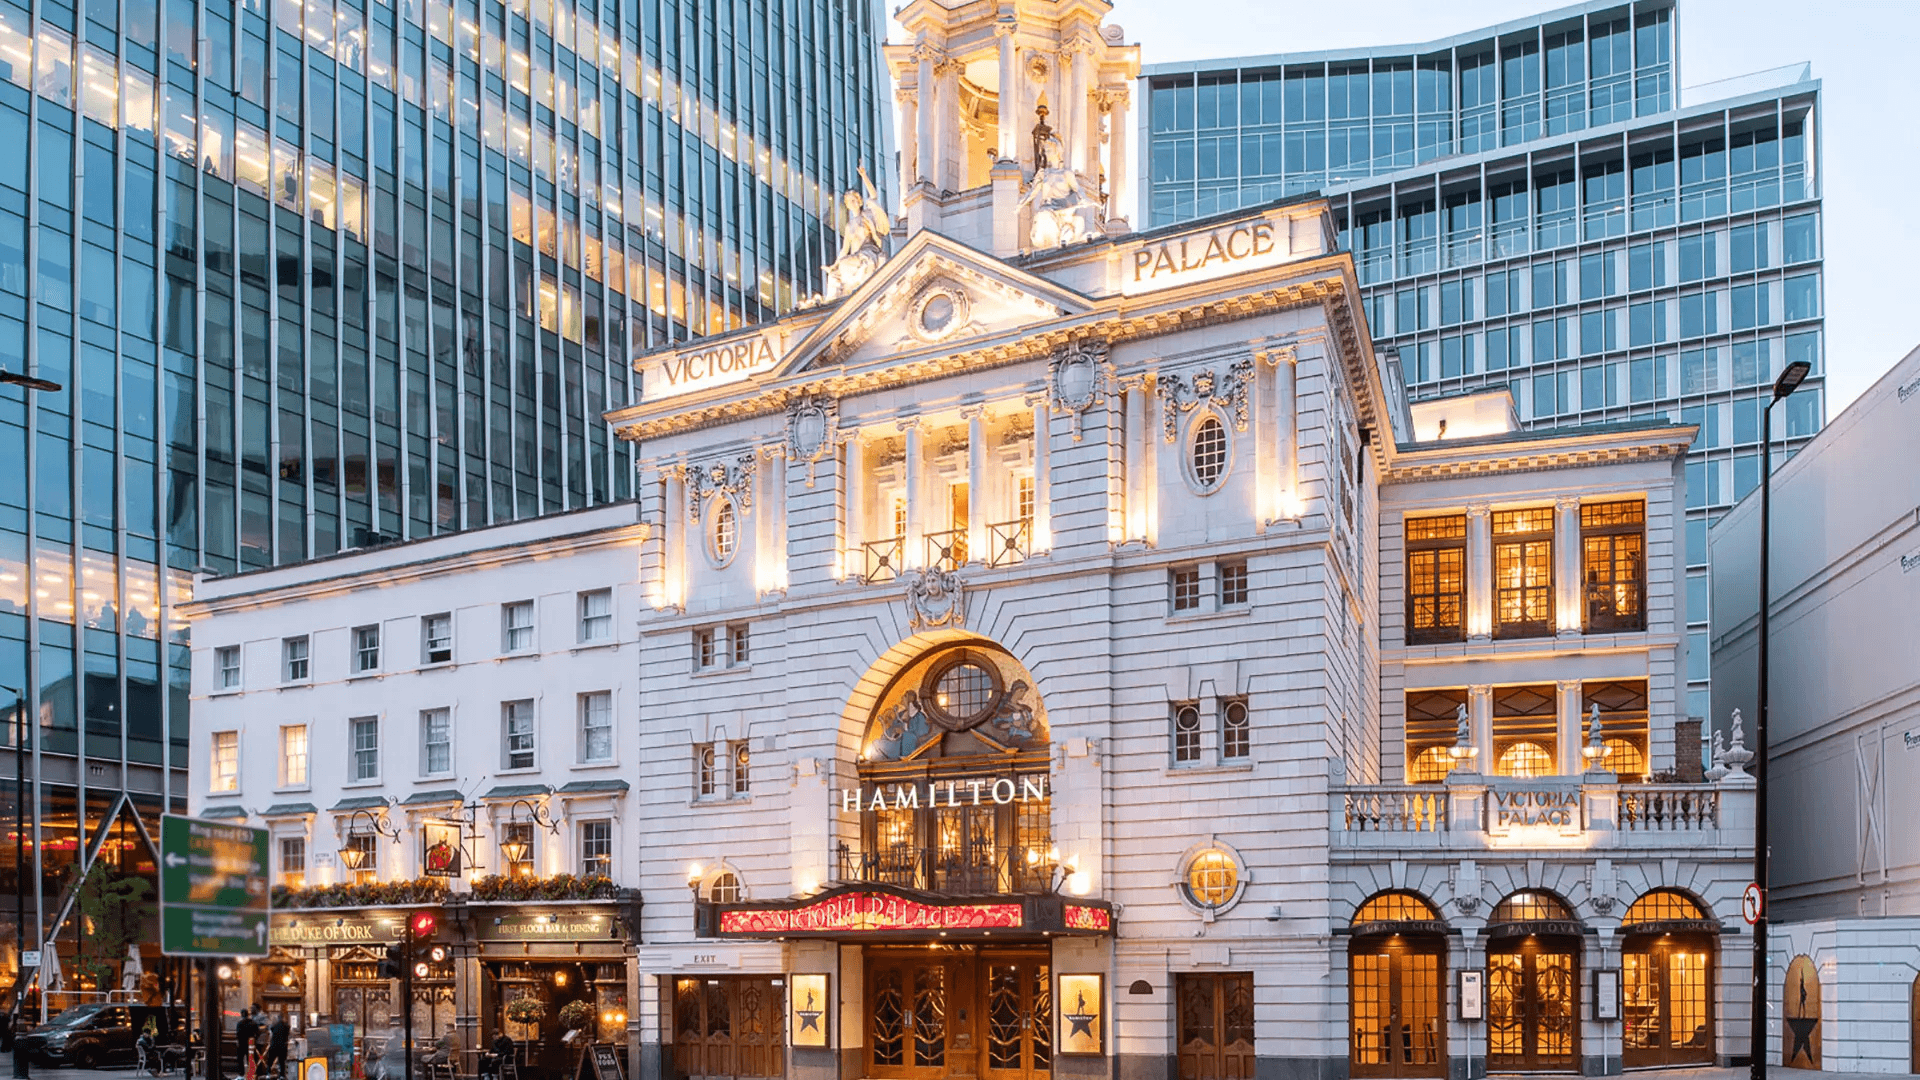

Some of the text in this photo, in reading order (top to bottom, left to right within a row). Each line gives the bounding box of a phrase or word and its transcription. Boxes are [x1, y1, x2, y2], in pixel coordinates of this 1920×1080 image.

[1134, 222, 1275, 281] PALACE
[662, 336, 777, 386] VICTORIA
[842, 776, 1046, 812] HAMILTON
[1493, 791, 1578, 808] VICTORIA
[1498, 810, 1572, 826] PALACE
[777, 896, 959, 928] VICTORIA PALACE
[290, 926, 321, 940] DUKE
[323, 926, 340, 940] OF
[340, 925, 373, 939] YORK
[520, 924, 545, 934] FLOOR
[545, 924, 560, 933] BAR
[694, 955, 716, 963] EXIT
